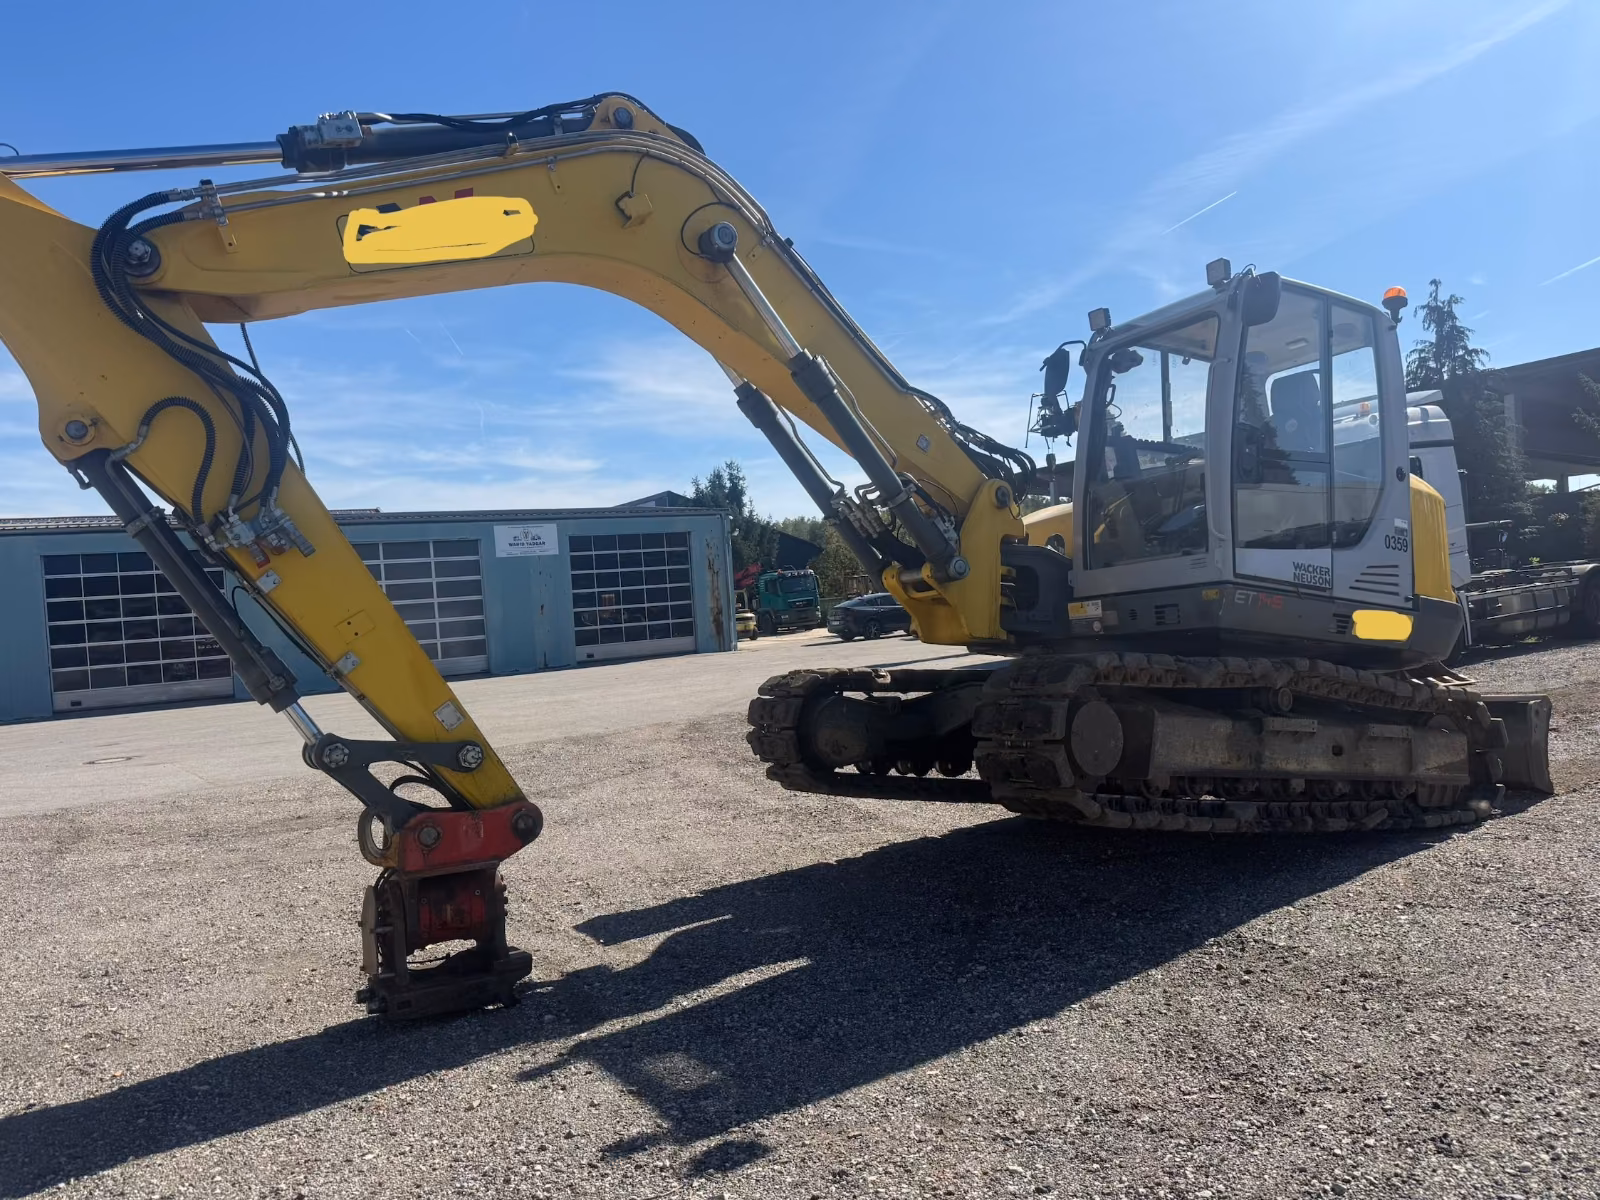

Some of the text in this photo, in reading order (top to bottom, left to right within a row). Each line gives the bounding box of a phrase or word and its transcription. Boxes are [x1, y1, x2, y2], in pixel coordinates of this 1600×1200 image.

[1384, 534, 1408, 553] 0359
[1292, 561, 1331, 577] WACKER
[1292, 572, 1331, 587] NEUSON
